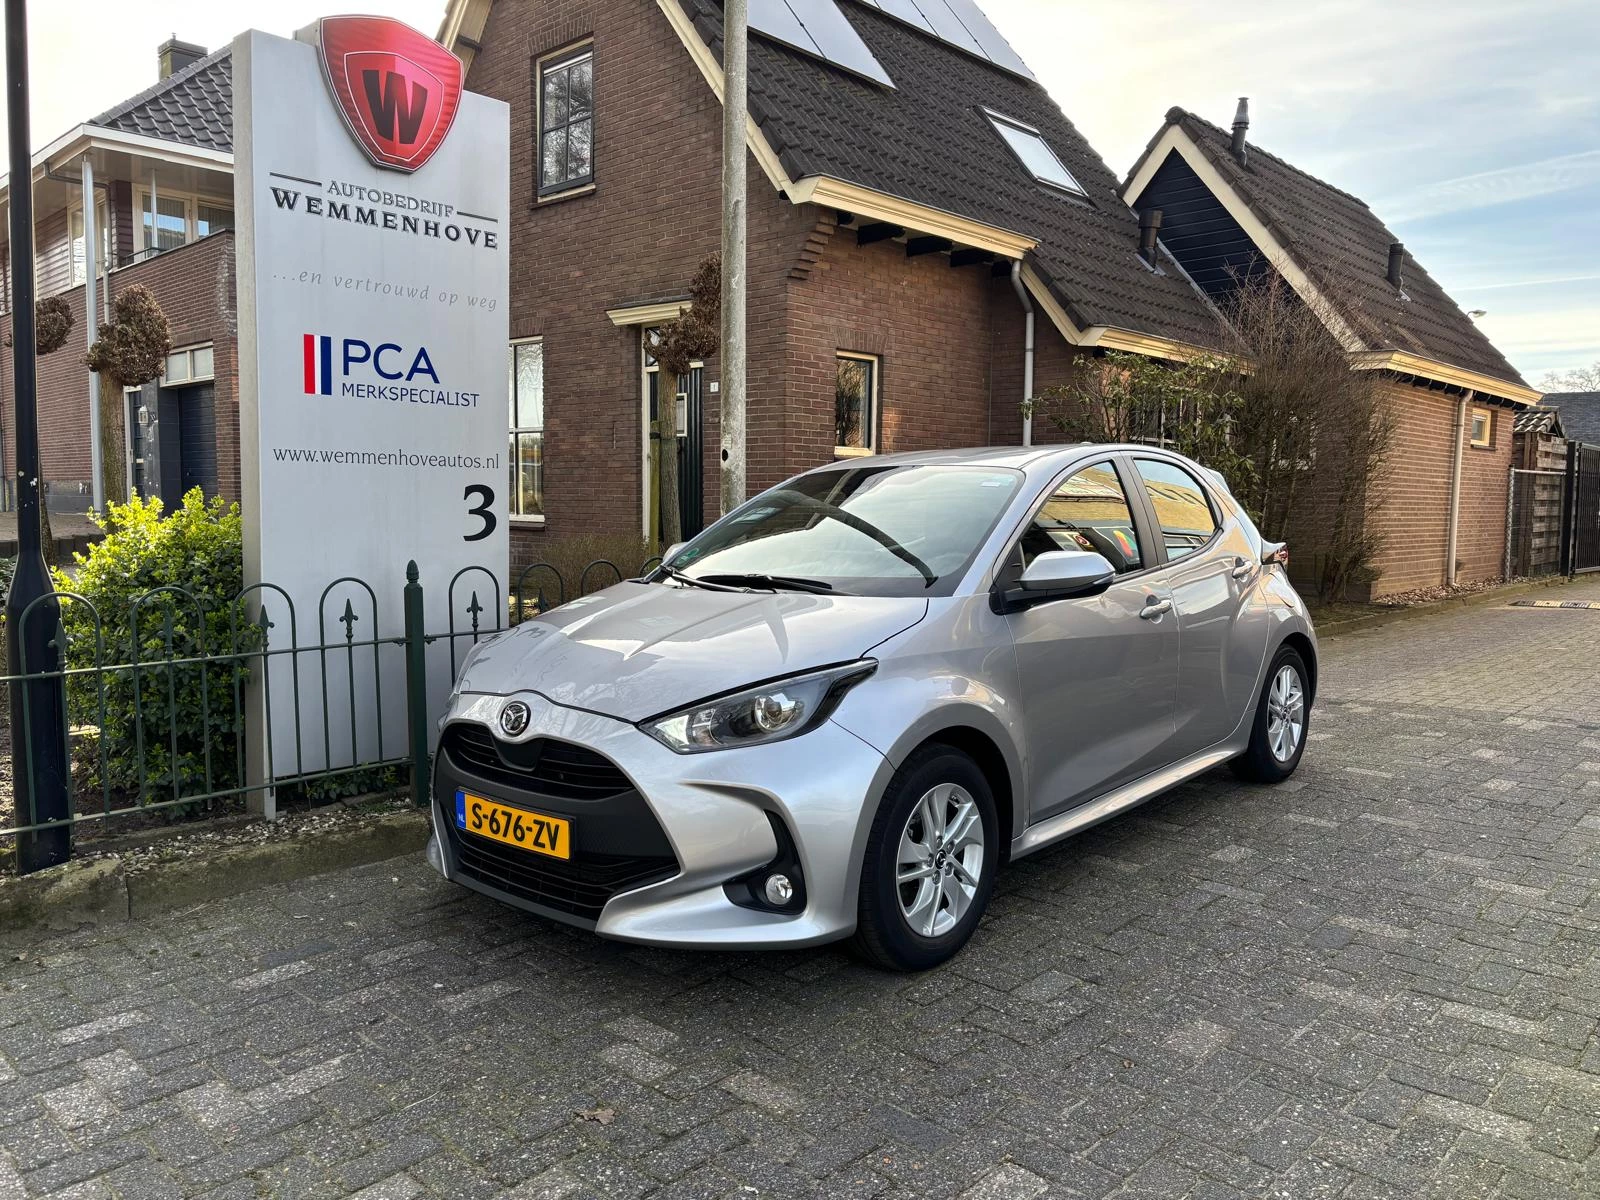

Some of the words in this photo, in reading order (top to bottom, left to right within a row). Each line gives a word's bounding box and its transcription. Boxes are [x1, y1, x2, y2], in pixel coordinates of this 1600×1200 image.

[362, 69, 428, 145] W
[269, 186, 498, 250] WEMMENHOVE
[326, 180, 455, 218] AUTOBEDRIJF
[333, 275, 430, 300] vertrouwd
[438, 291, 458, 307] op
[467, 295, 497, 312] weg
[342, 338, 440, 384] PCA
[342, 382, 480, 407] MERKSPECIALIST
[272, 448, 500, 470] www.wemmenhoveautos.nl
[462, 483, 497, 542] 3
[472, 803, 559, 850] S-676-ZV
